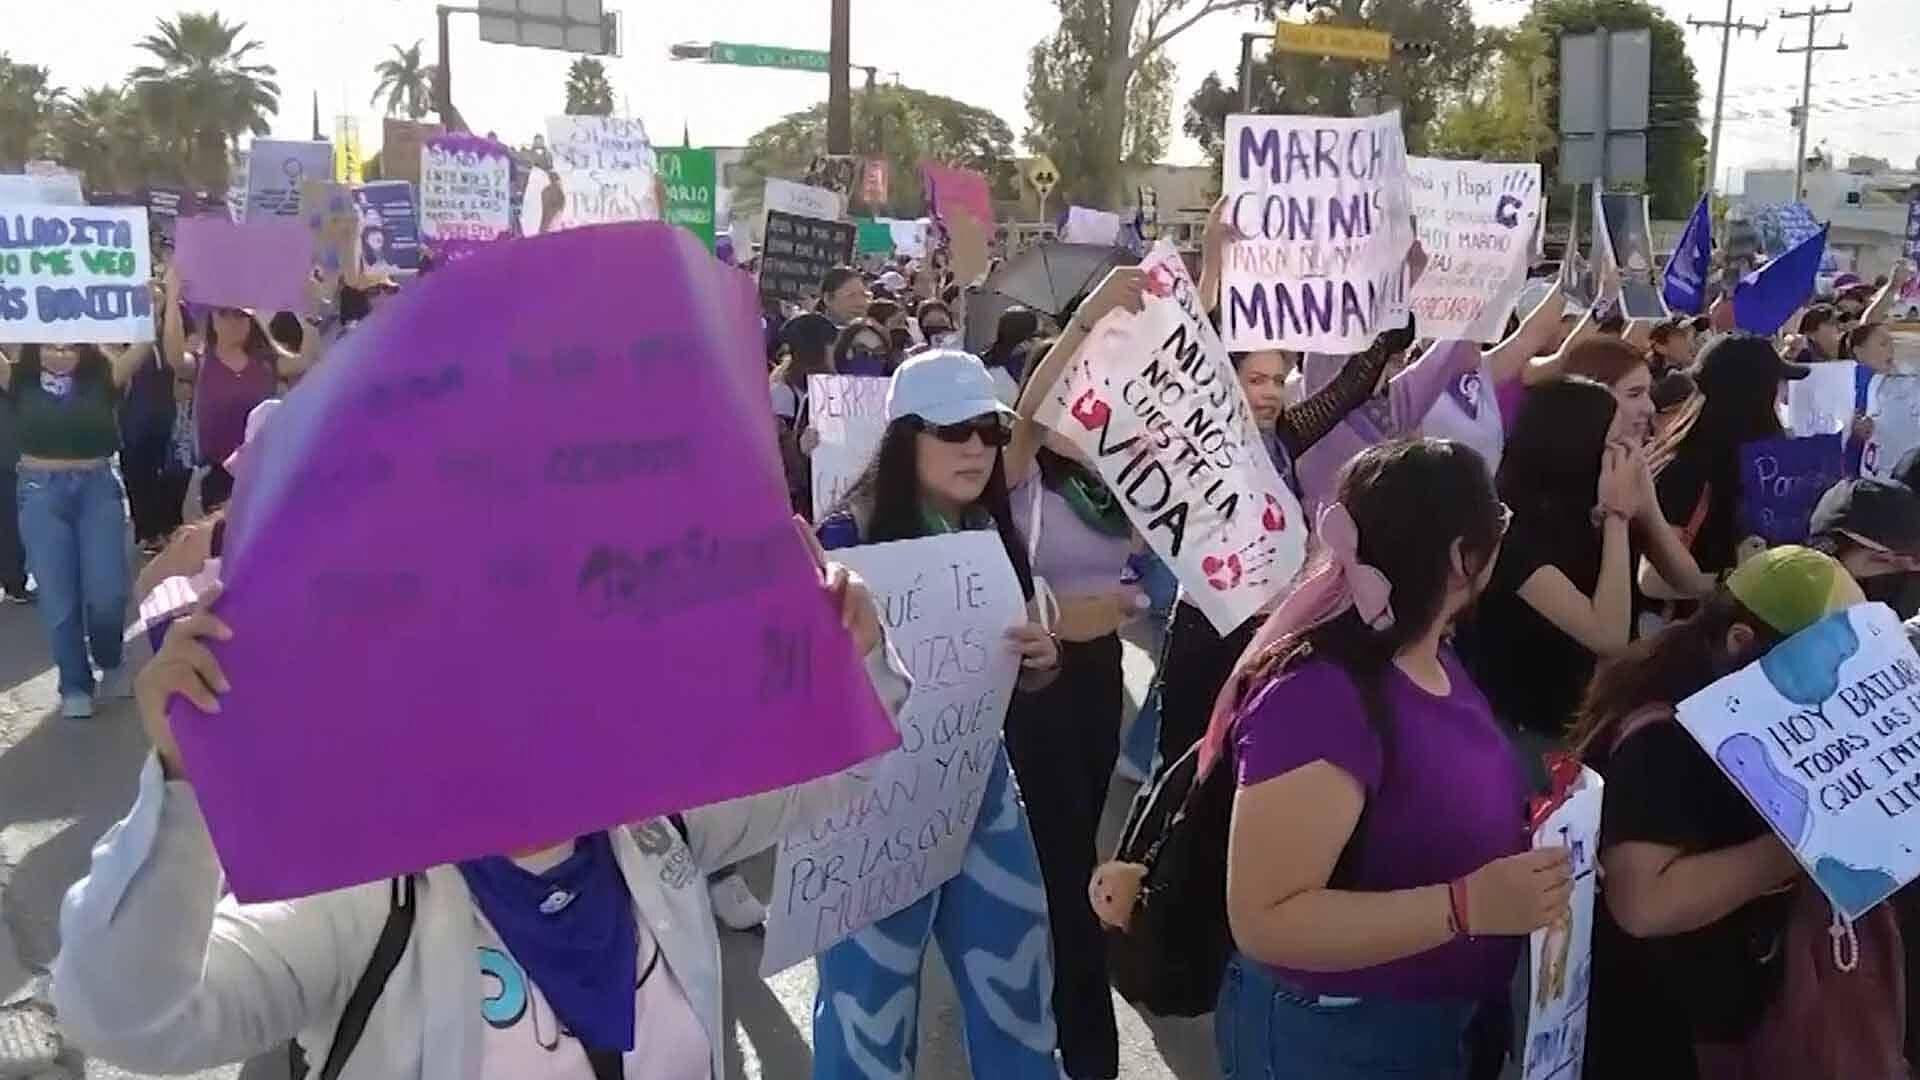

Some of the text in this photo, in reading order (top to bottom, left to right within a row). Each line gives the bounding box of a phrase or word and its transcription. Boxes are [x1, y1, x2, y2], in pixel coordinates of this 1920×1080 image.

[1233, 192, 1315, 241] CON
[30, 251, 74, 276] ME
[80, 251, 136, 278] VEO
[1141, 359, 1237, 470] NO NOS
[1098, 415, 1191, 558] VIDA
[1203, 478, 1239, 521] LA
[951, 562, 987, 611] TE
[1768, 702, 1834, 759] HOY
[1794, 706, 1912, 782] TODAS LAS
[788, 855, 852, 916] POR
